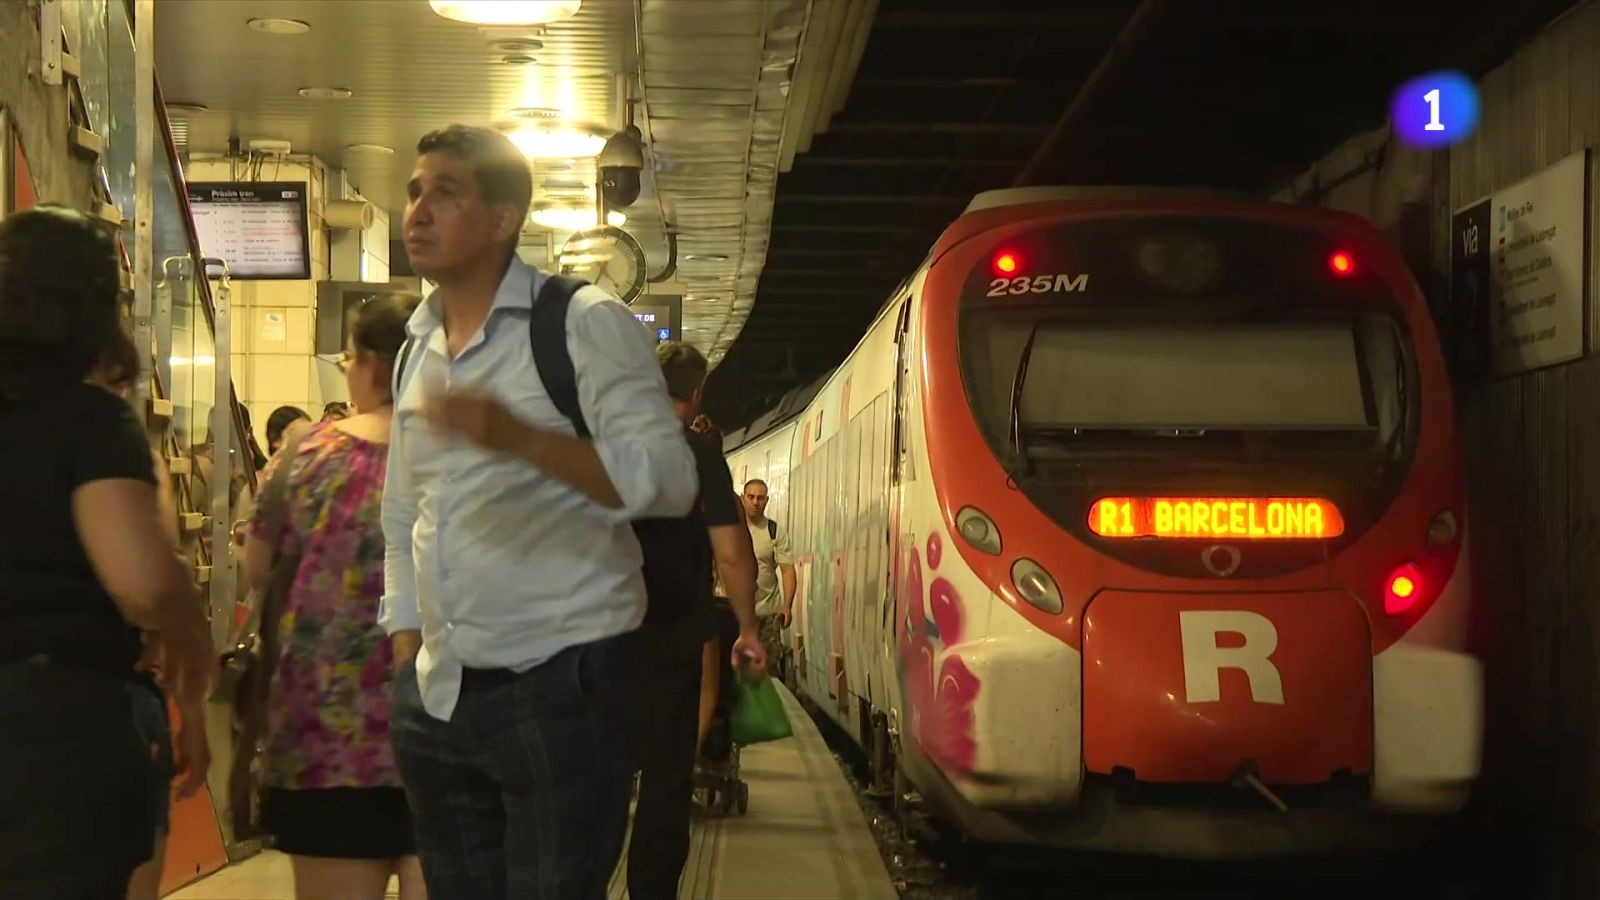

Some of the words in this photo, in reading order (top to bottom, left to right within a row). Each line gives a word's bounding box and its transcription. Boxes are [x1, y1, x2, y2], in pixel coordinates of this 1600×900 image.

[1463, 217, 1478, 257] via
[987, 274, 1088, 297] 235M
[1100, 502, 1134, 533] R1
[1155, 502, 1325, 535] BARCELONA
[1179, 610, 1285, 705] R
